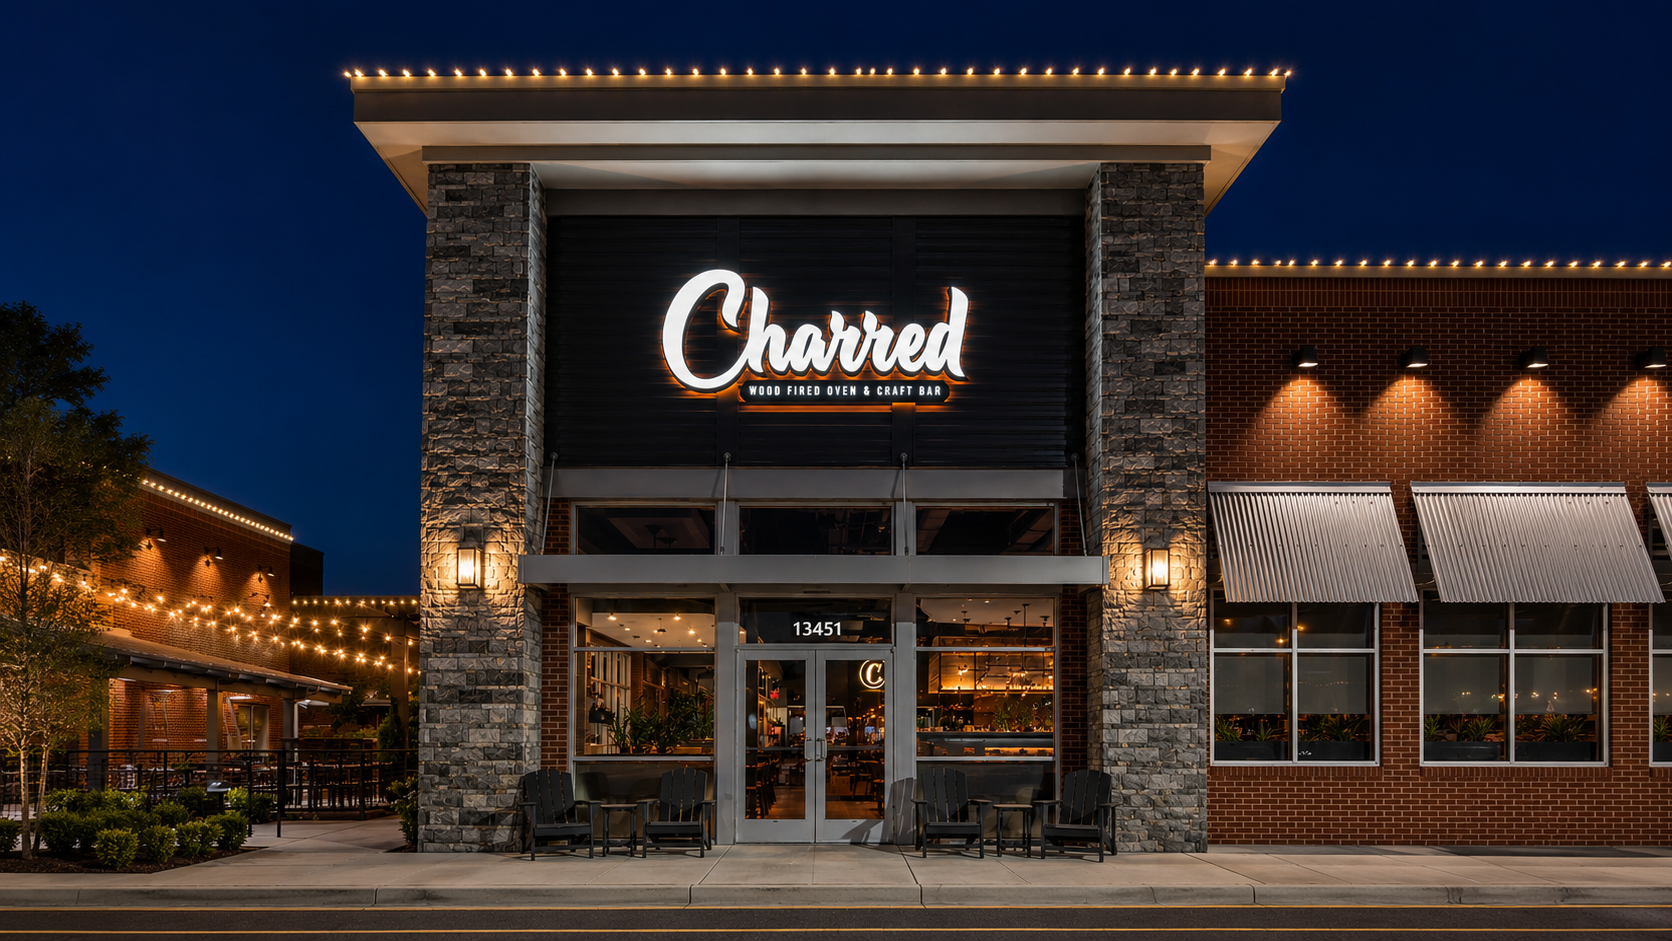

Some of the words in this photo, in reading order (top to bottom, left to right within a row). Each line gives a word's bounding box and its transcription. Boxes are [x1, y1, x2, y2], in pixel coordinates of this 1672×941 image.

[662, 268, 969, 390] Charred
[748, 385, 781, 396] WOOD
[787, 385, 820, 396] FIRED
[827, 385, 857, 396] OVEN
[863, 385, 871, 396] &
[876, 385, 913, 396] CRAFT
[919, 385, 941, 396] BAR
[793, 621, 842, 637] 13451
[866, 662, 884, 685] C
